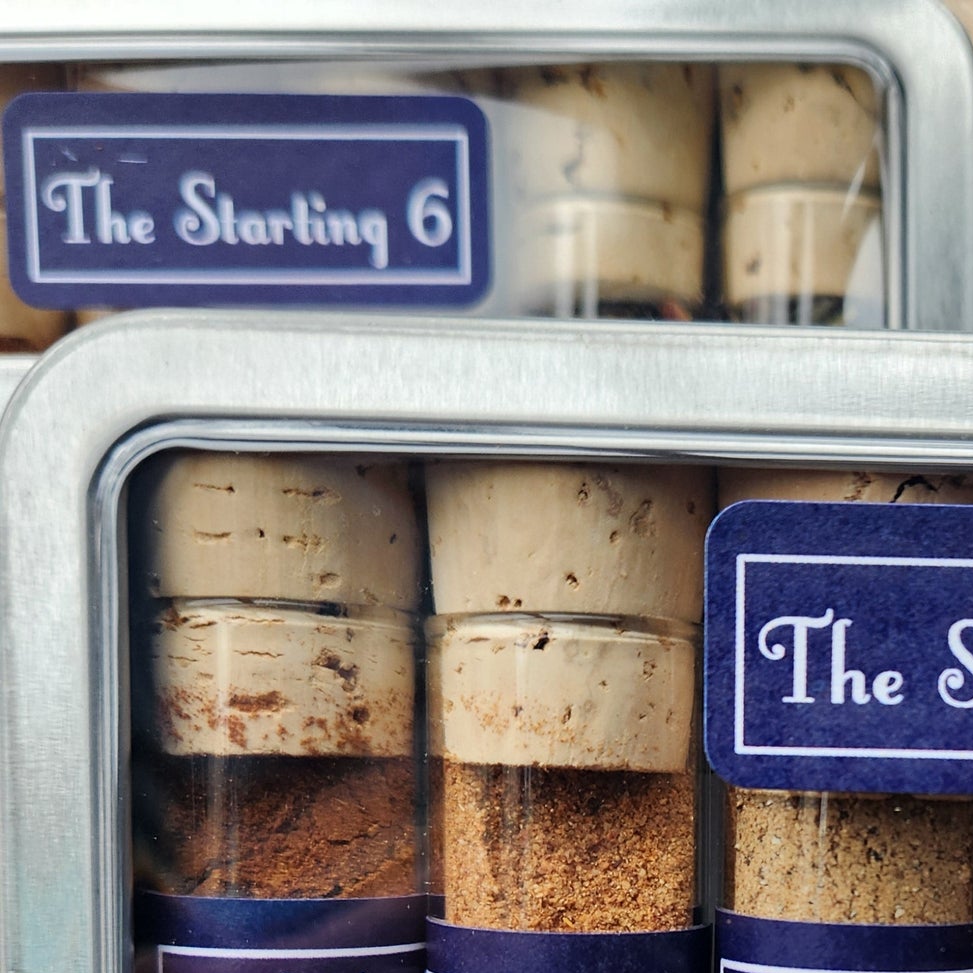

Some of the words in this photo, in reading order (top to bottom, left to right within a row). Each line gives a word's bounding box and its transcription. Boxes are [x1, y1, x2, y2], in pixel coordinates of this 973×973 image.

[41, 168, 156, 245] The
[174, 170, 389, 270] Starting
[406, 177, 453, 248] 6
[757, 608, 904, 706] The
